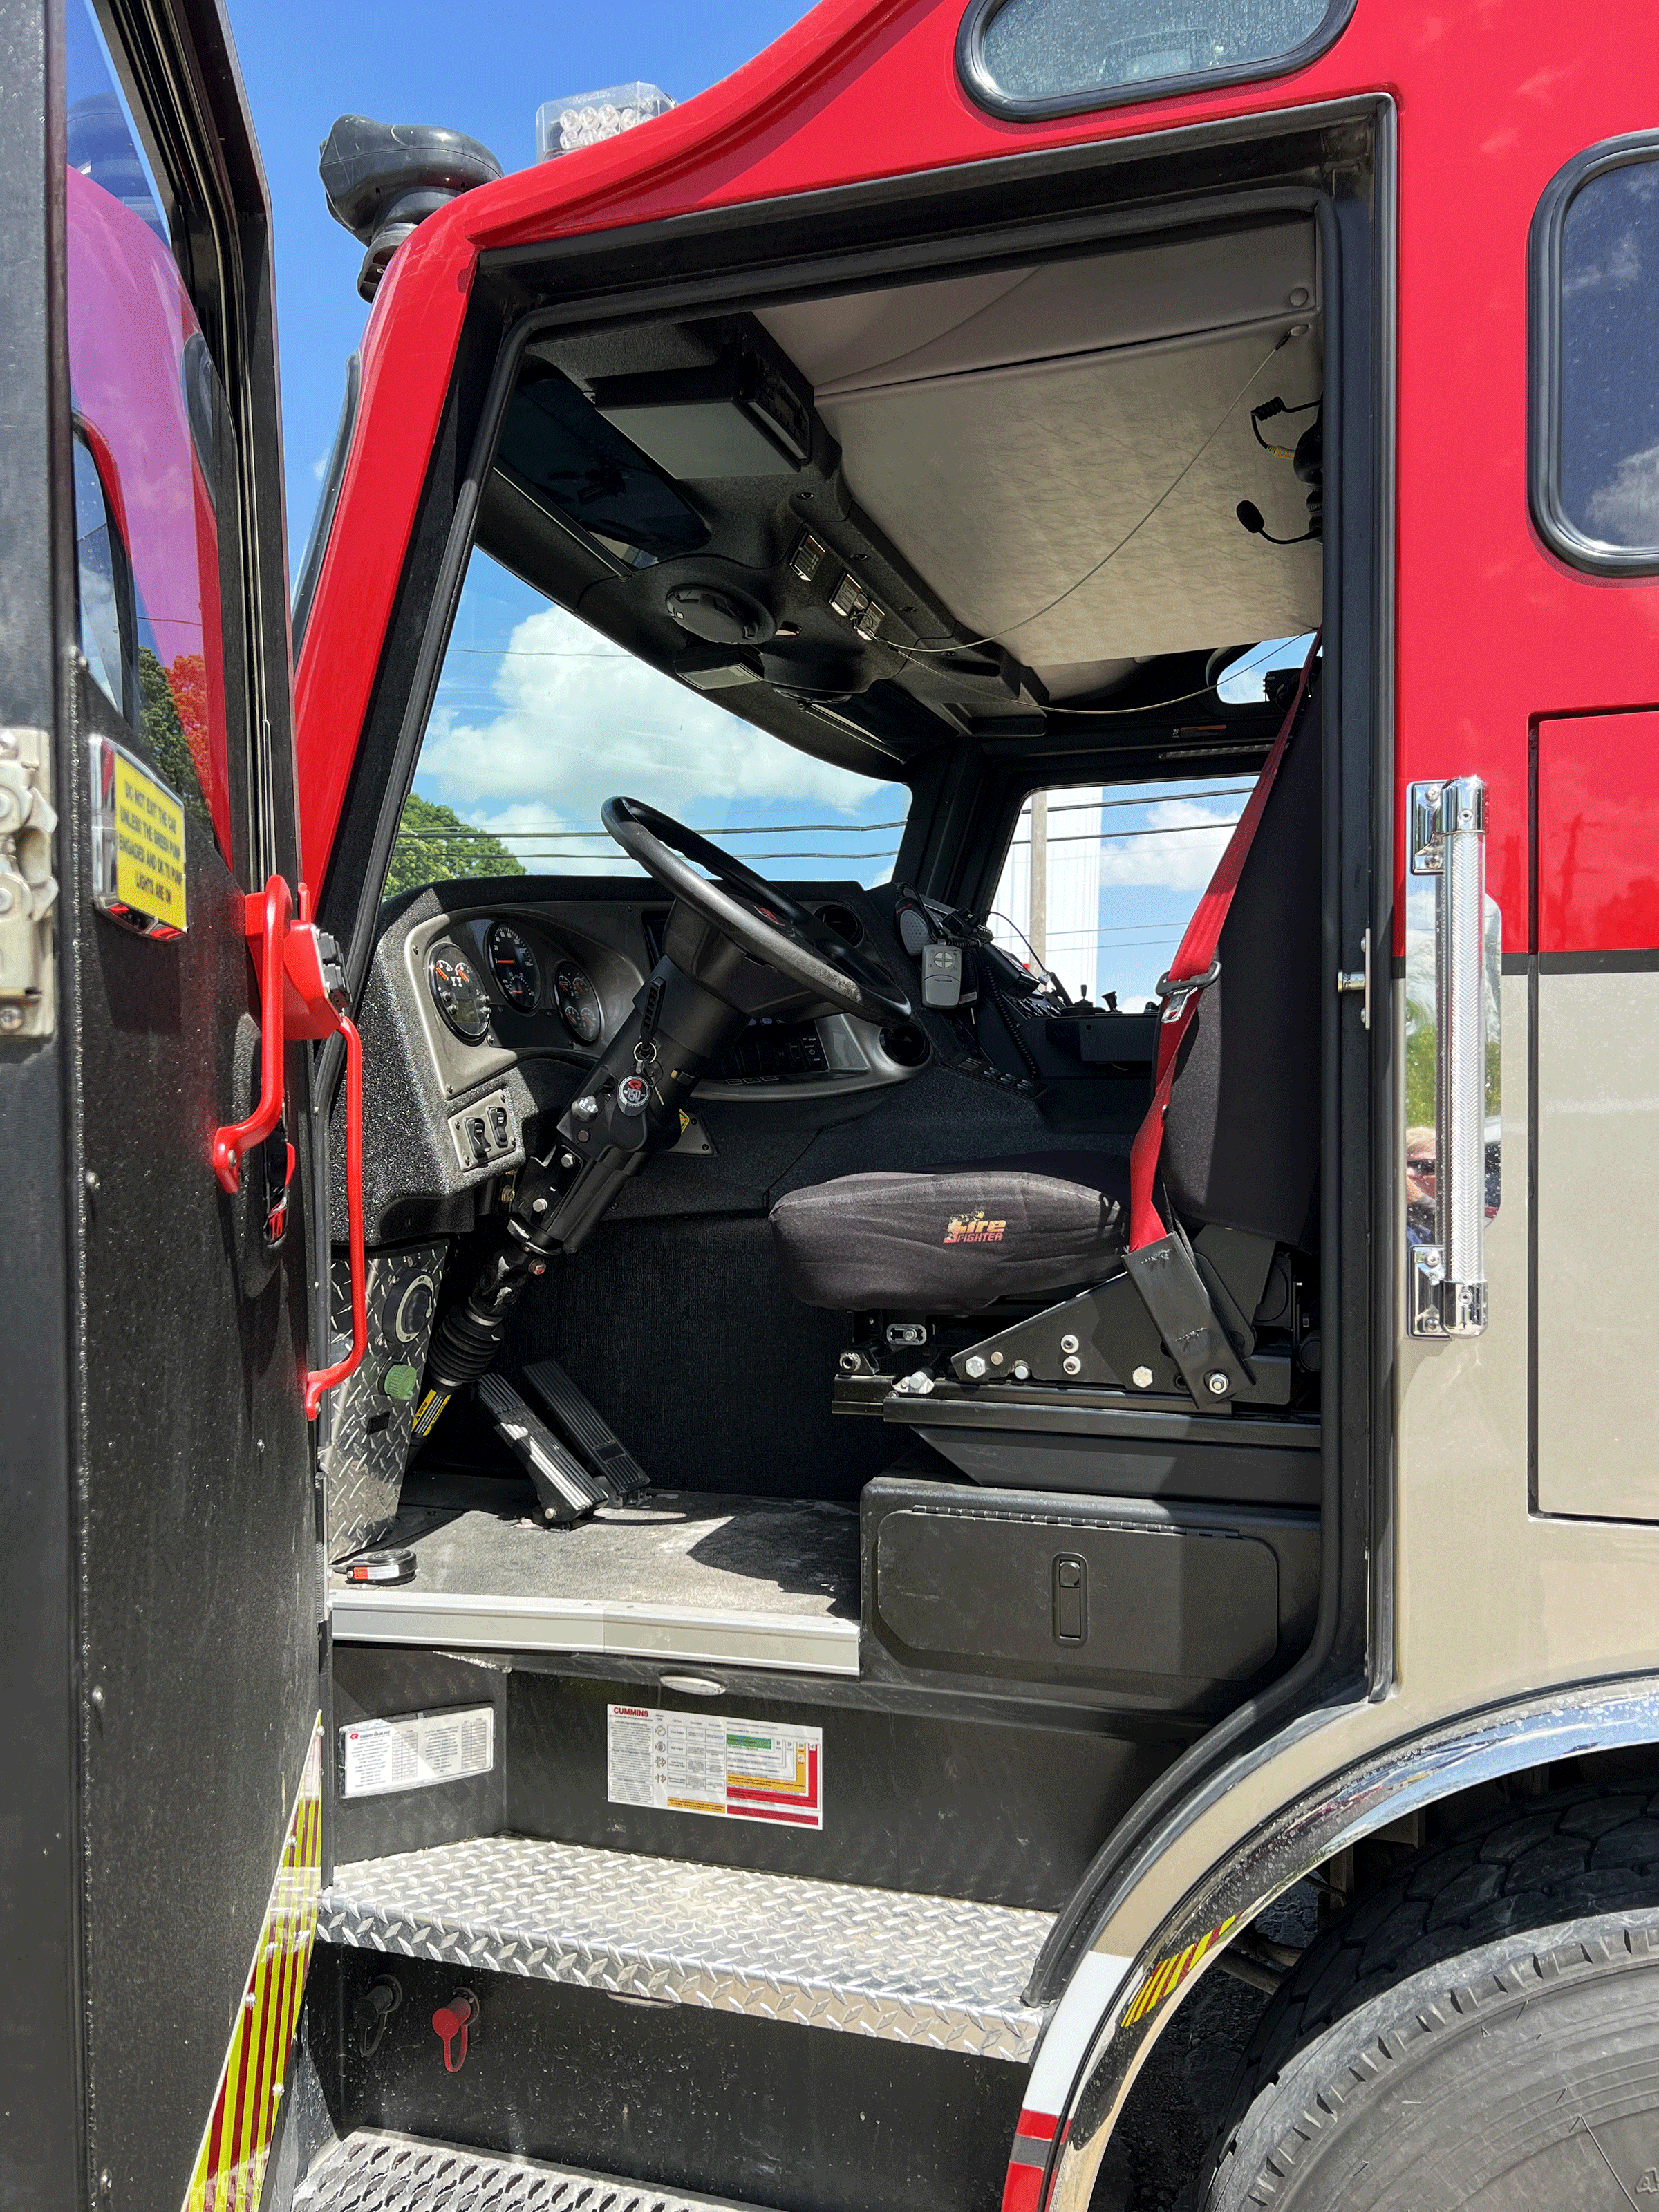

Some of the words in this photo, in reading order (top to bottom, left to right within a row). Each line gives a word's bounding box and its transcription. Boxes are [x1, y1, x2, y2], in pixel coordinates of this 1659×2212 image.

[120, 804, 142, 834] UNLESS
[142, 821, 153, 842] THE
[957, 1232, 1004, 1243] FIGHTER
[613, 1706, 649, 1718] CUMMINS
